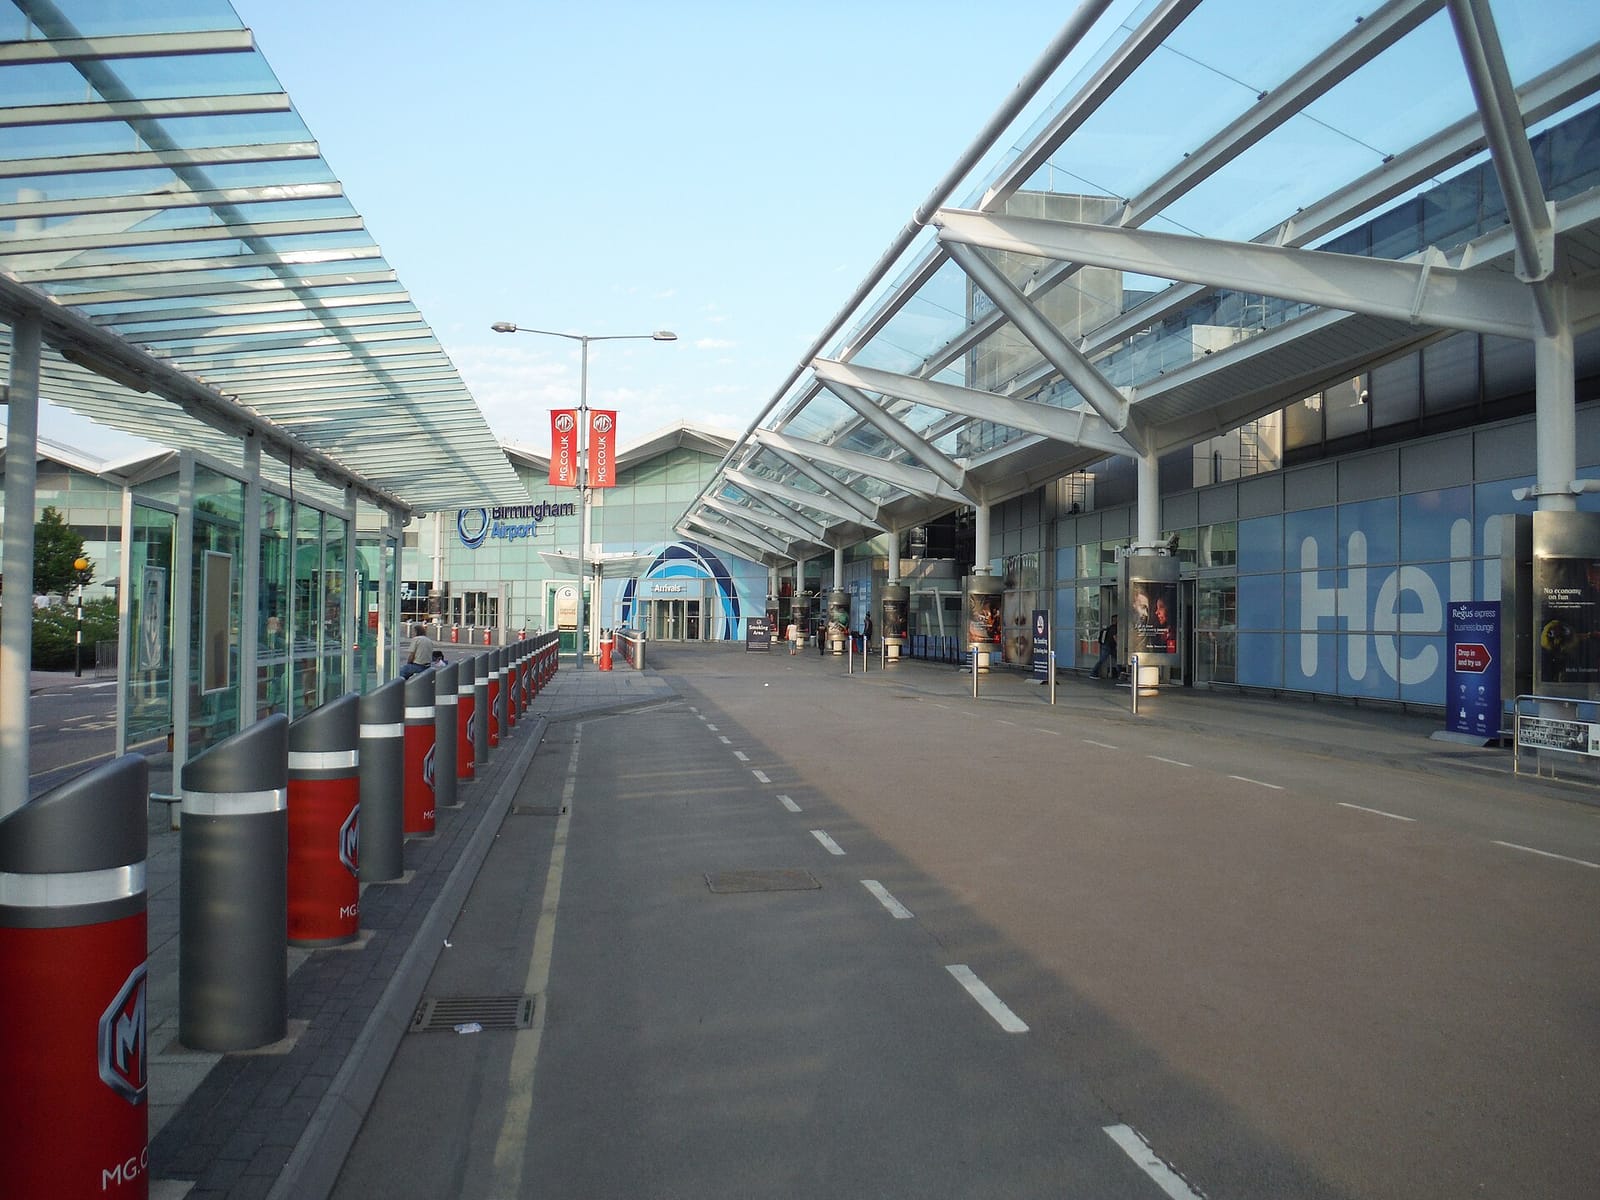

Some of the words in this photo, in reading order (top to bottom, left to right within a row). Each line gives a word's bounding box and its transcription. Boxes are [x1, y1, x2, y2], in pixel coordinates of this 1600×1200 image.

[556, 415, 572, 431] MG
[594, 416, 610, 432] MG
[560, 435, 569, 481] MG.CO.UK
[598, 436, 607, 482] MG.CO.UK
[492, 500, 575, 521] Birmingham
[491, 521, 538, 542] Airport
[565, 589, 572, 597] G
[654, 584, 681, 593] Arrivals
[1452, 608, 1473, 620] Regus
[1474, 610, 1496, 618] express
[1458, 649, 1469, 657] Drop
